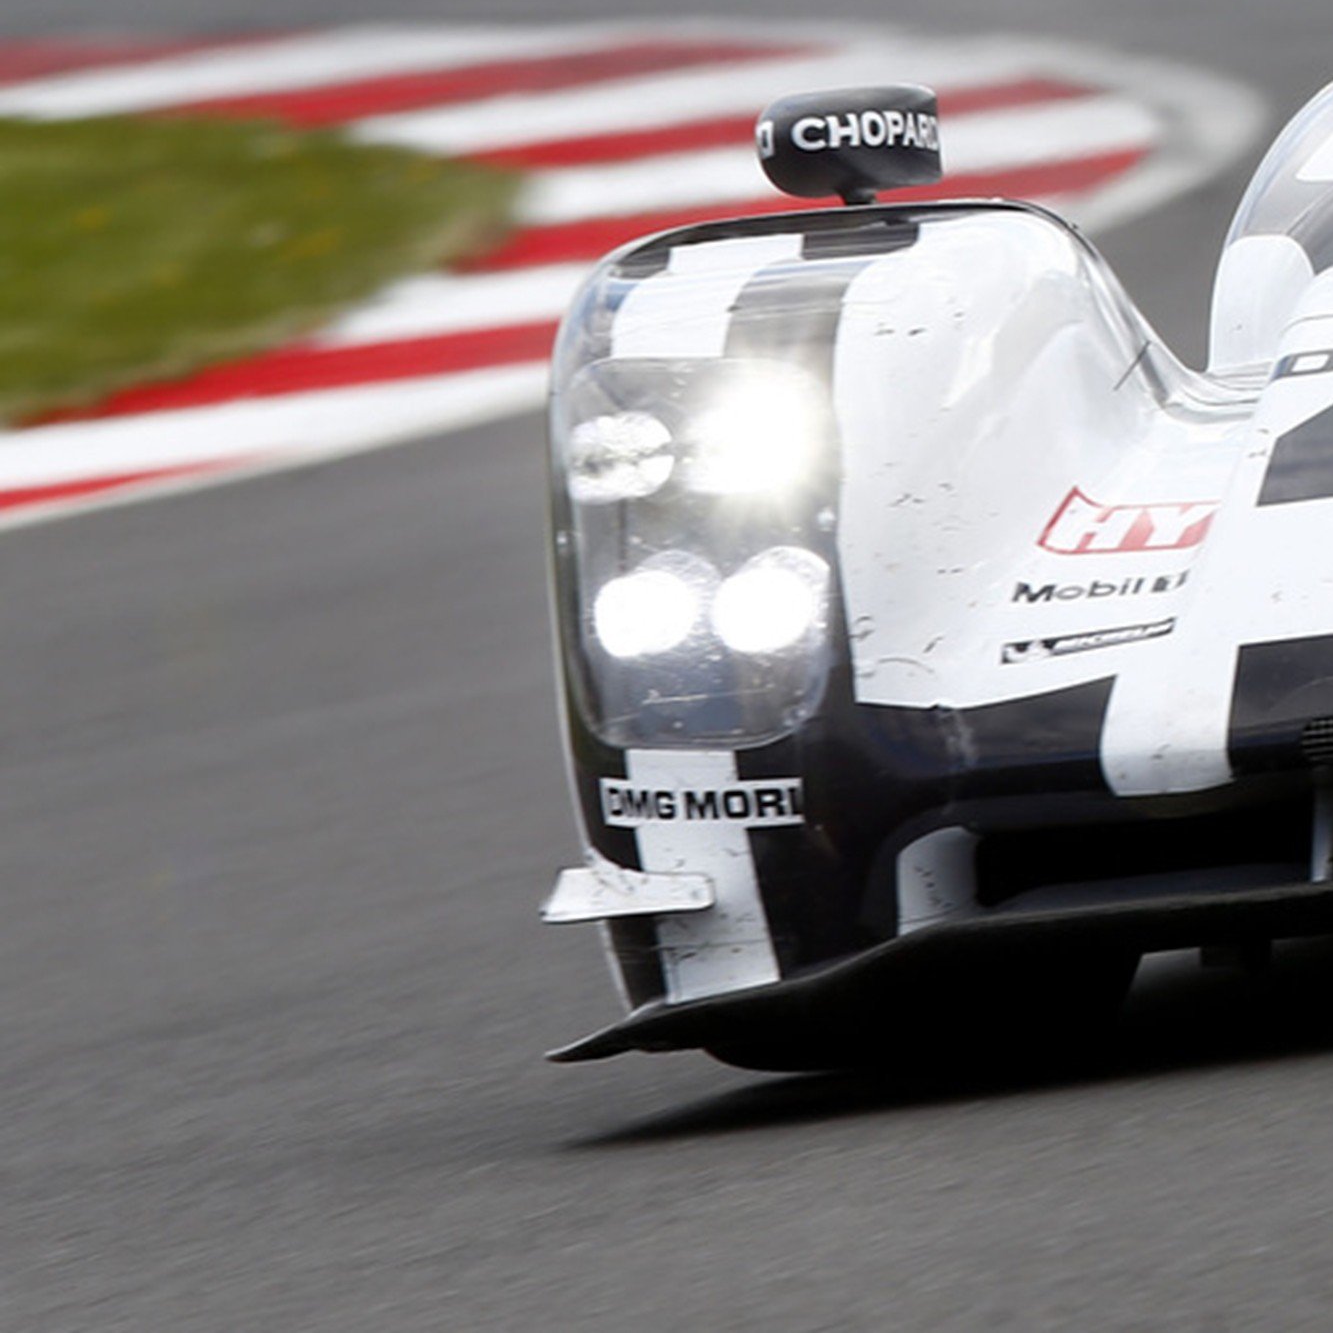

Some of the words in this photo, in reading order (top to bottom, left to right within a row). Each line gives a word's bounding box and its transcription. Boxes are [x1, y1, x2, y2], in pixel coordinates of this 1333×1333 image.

[1011, 577, 1145, 603] Mobil
[607, 787, 677, 820] DMG
[684, 785, 802, 820] MORI
